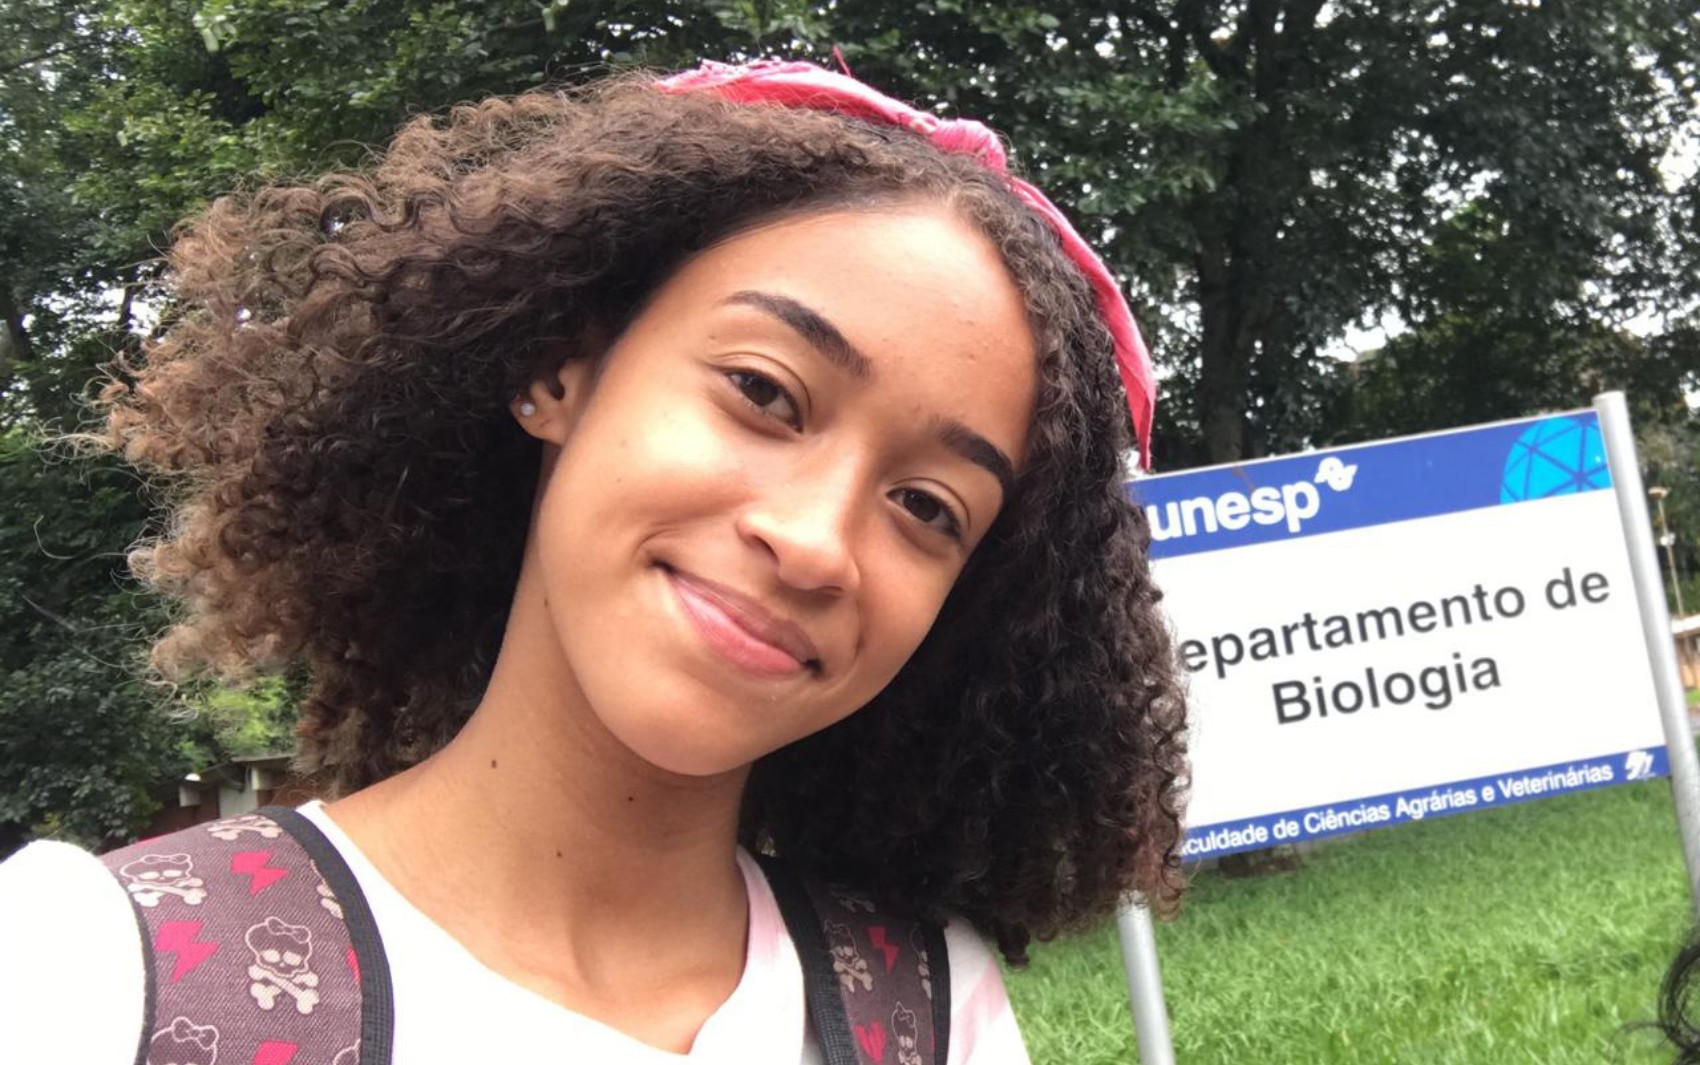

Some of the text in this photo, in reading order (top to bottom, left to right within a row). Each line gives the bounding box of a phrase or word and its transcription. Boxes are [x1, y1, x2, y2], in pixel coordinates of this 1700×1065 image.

[1146, 480, 1320, 541] unesp
[1178, 566, 1610, 679] epartamento de
[1272, 652, 1502, 725] Biologia
[1181, 762, 1614, 855] culdade de Ciências Agrárias e Veterinárias
